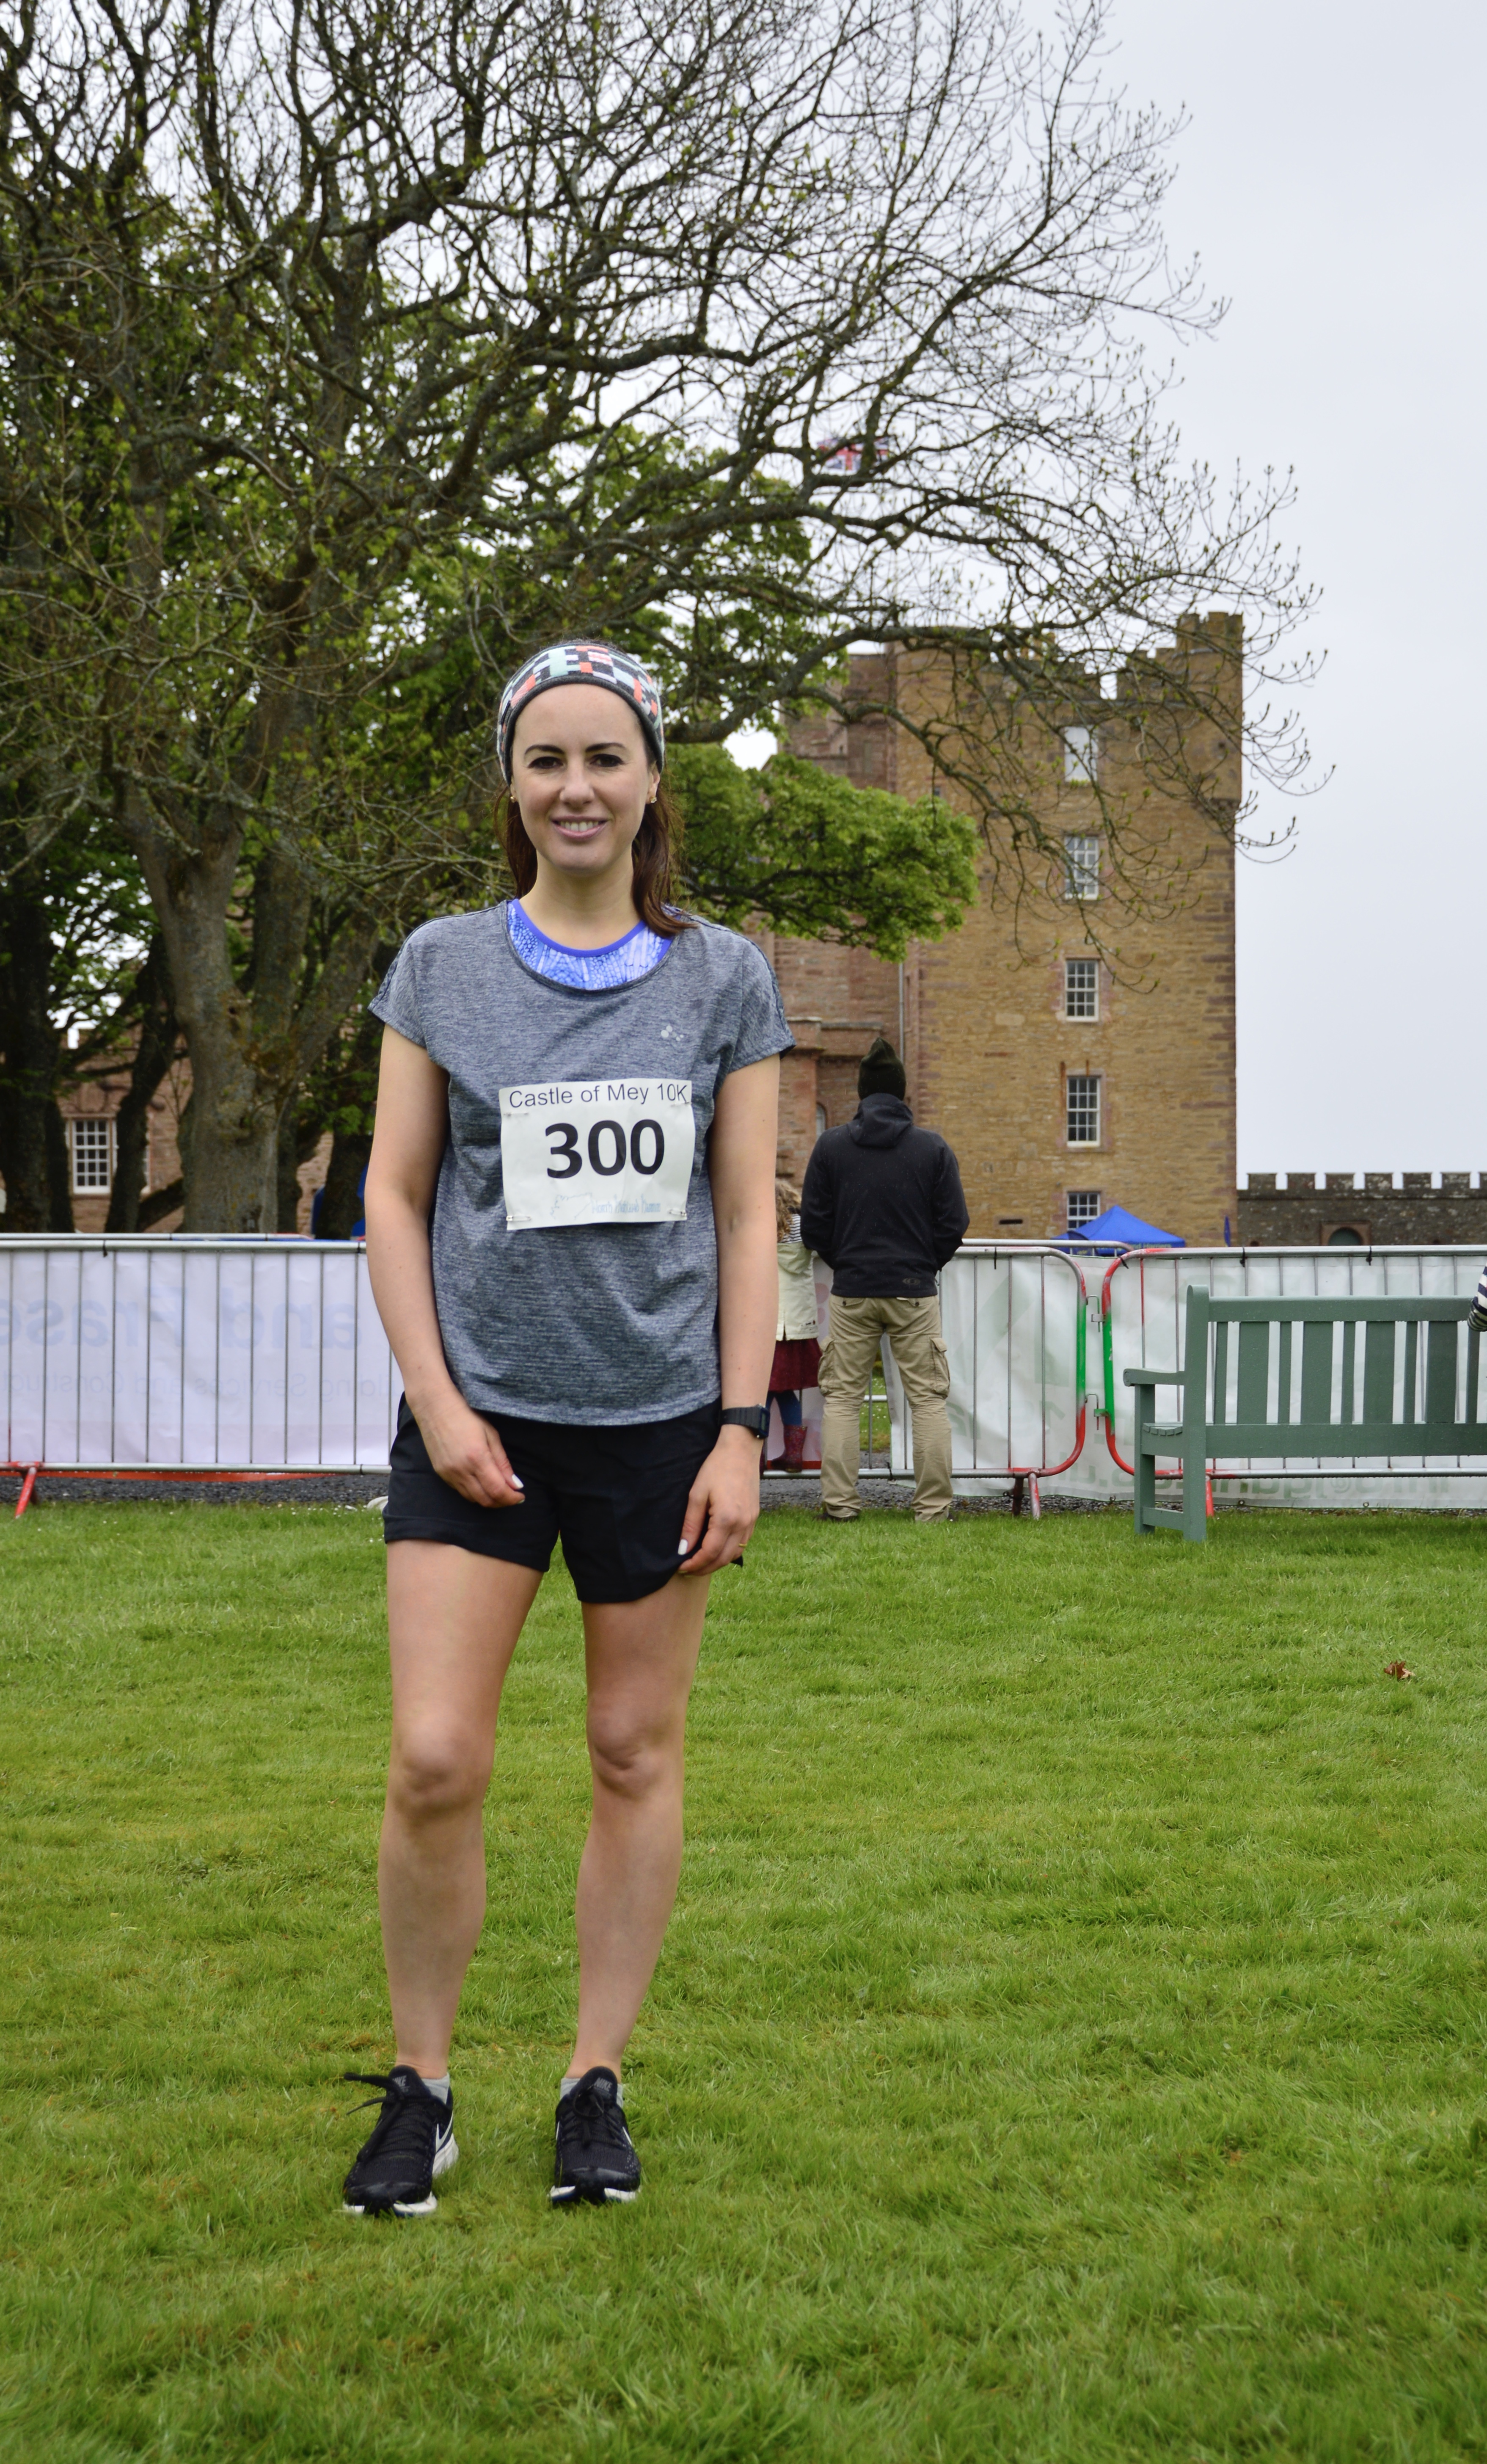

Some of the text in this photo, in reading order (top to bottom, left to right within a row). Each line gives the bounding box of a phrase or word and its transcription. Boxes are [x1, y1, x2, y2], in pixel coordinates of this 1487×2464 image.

[509, 1083, 688, 1108] Castle of Mey 10K
[545, 1119, 665, 1179] 300
[594, 2077, 613, 2092] NIKE
